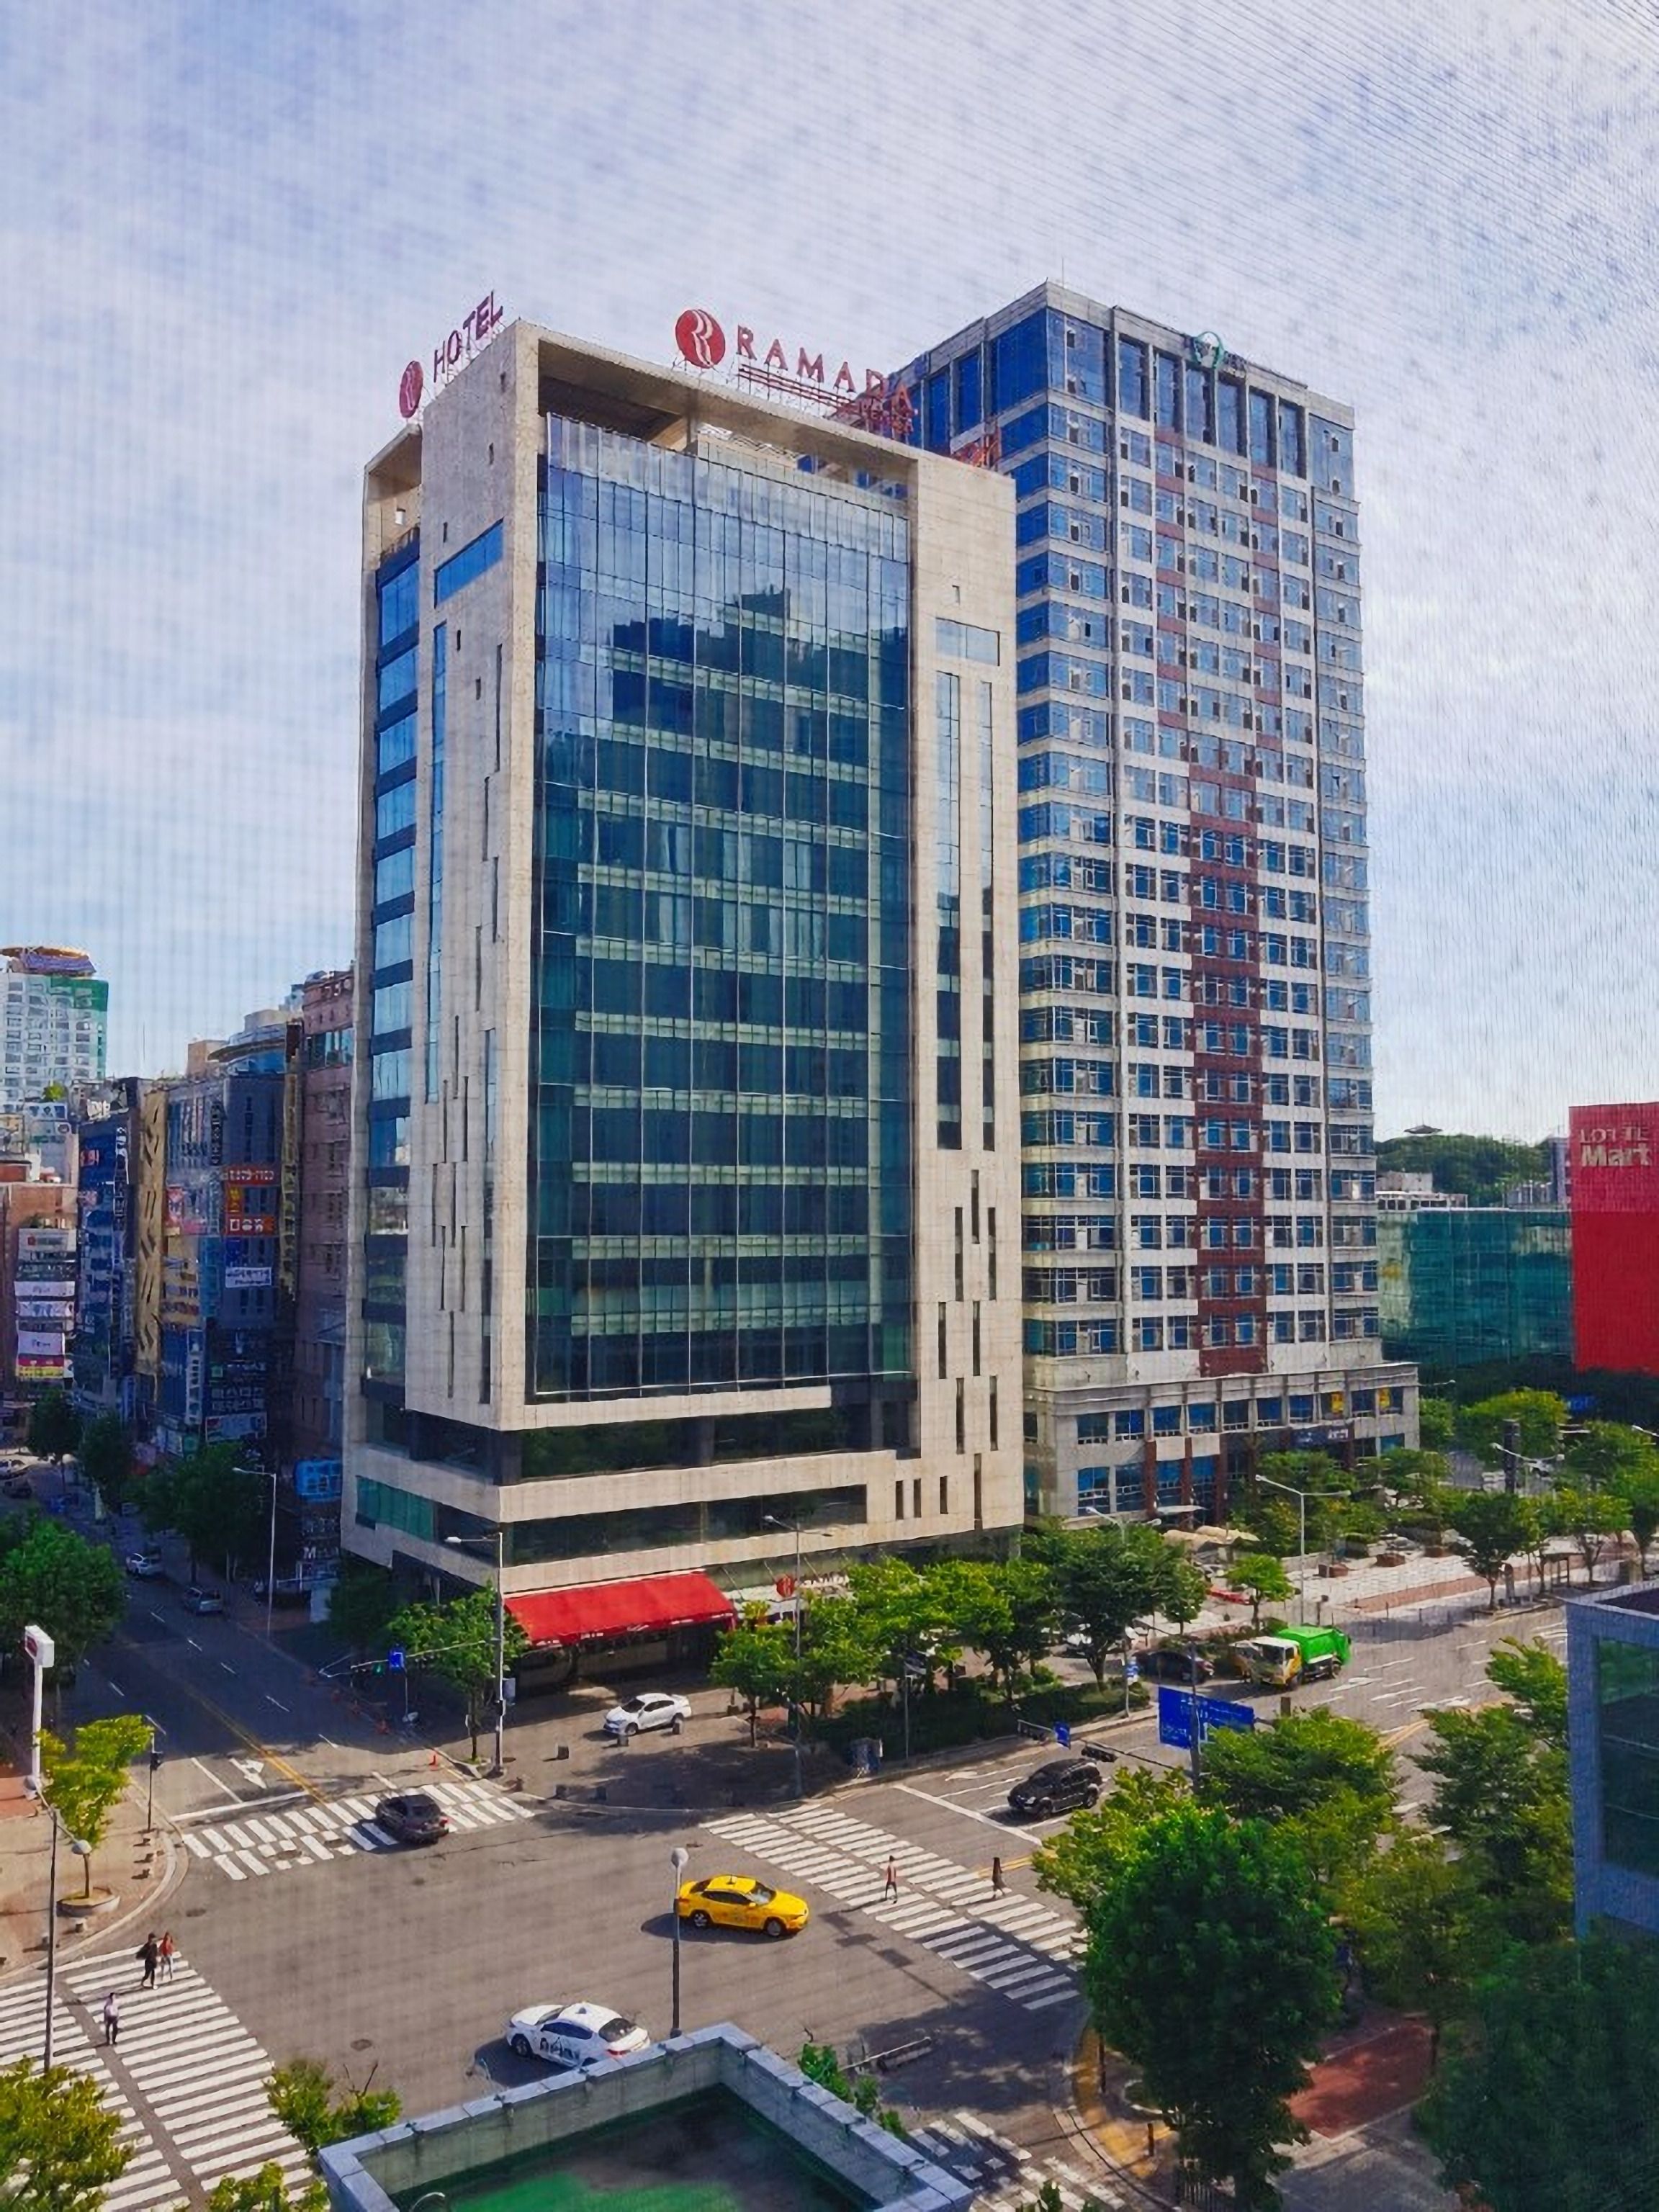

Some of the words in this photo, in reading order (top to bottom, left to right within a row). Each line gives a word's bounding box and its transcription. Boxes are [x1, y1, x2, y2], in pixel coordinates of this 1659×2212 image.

[433, 291, 503, 383] HOTEL
[737, 325, 913, 416] RAMADA
[1580, 1126, 1649, 1143] LOTTE
[1581, 1142, 1652, 1166] Mart
